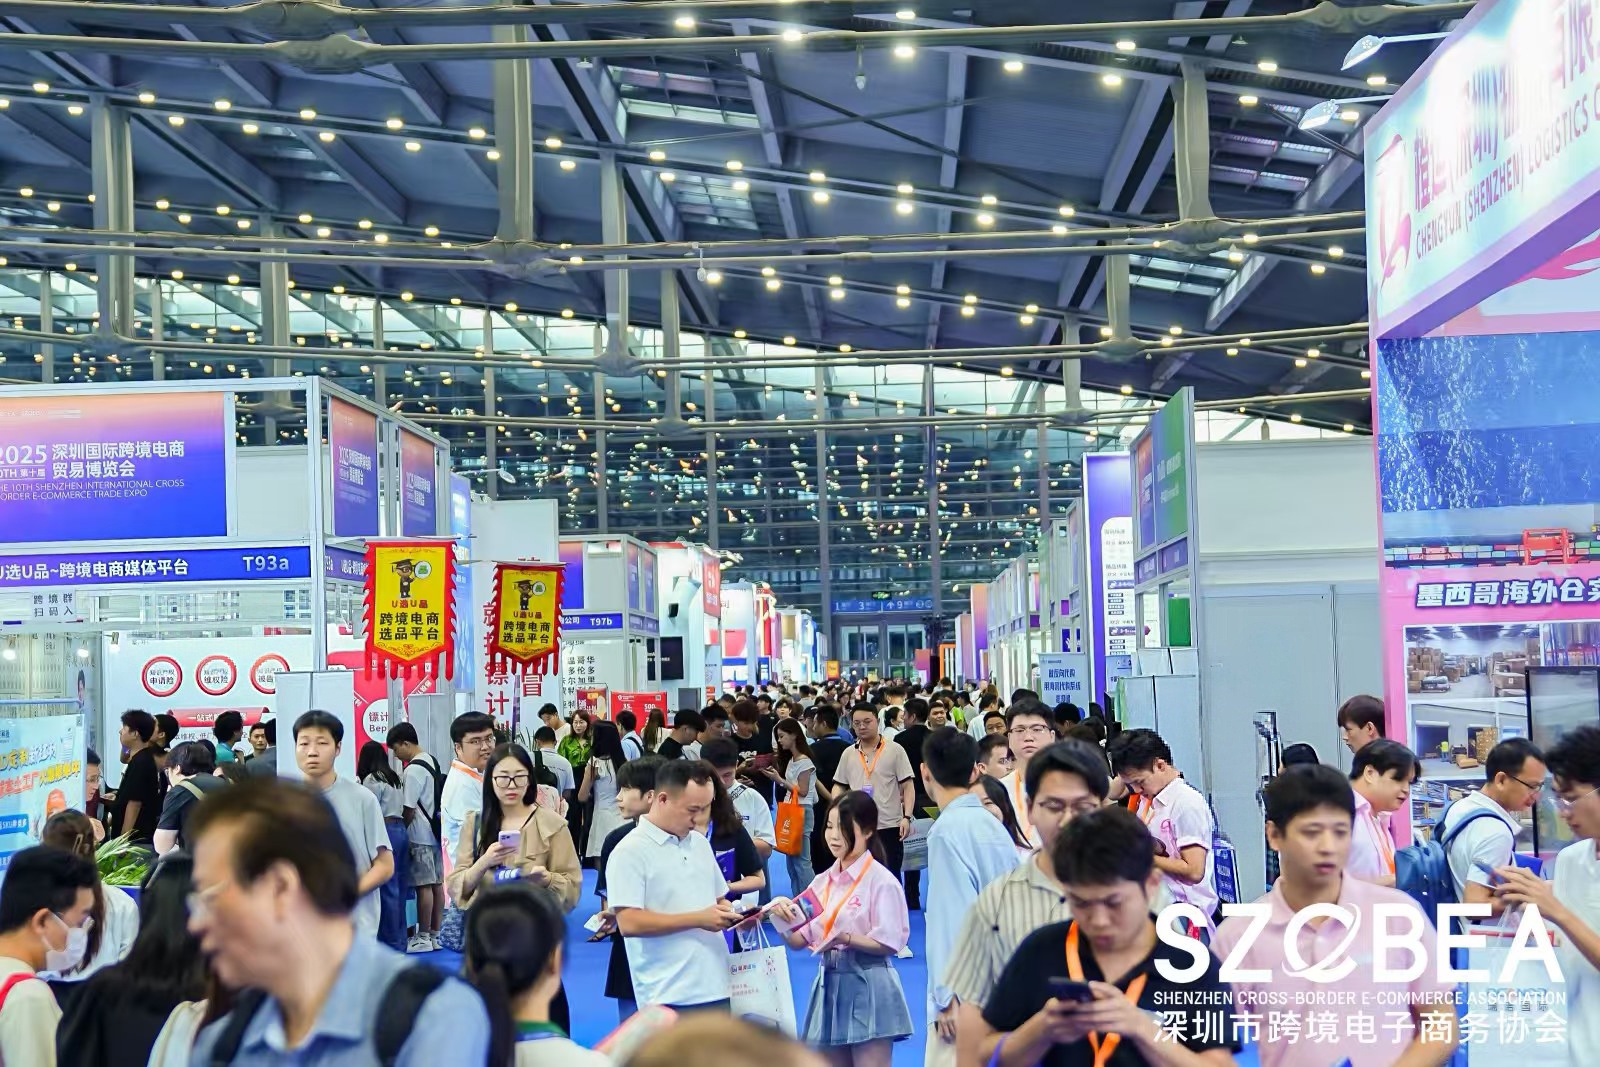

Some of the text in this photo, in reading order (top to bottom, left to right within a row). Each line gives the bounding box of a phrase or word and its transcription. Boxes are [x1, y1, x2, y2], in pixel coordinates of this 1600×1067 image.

[52, 440, 185, 461] 深圳国际跨境电商
[52, 460, 135, 479] 贸易博览会
[12, 483, 33, 492] 10TH
[35, 482, 83, 491] SHENZHEN
[85, 480, 154, 490] INTERNATIONAL
[156, 479, 185, 488] CROSS
[32, 490, 91, 500] E-COMMERCE
[93, 489, 122, 498] TRADE
[124, 488, 147, 498] EXPO
[243, 555, 290, 573] T93a
[379, 612, 439, 626] 跨境电商
[590, 618, 613, 626] T97b
[503, 620, 551, 632] 跨境电商
[379, 627, 439, 641] 选品平台
[502, 632, 550, 644] 选品平台
[567, 656, 595, 665] 温哥华
[567, 666, 595, 675] 多伦多
[150, 676, 174, 685] 申请险
